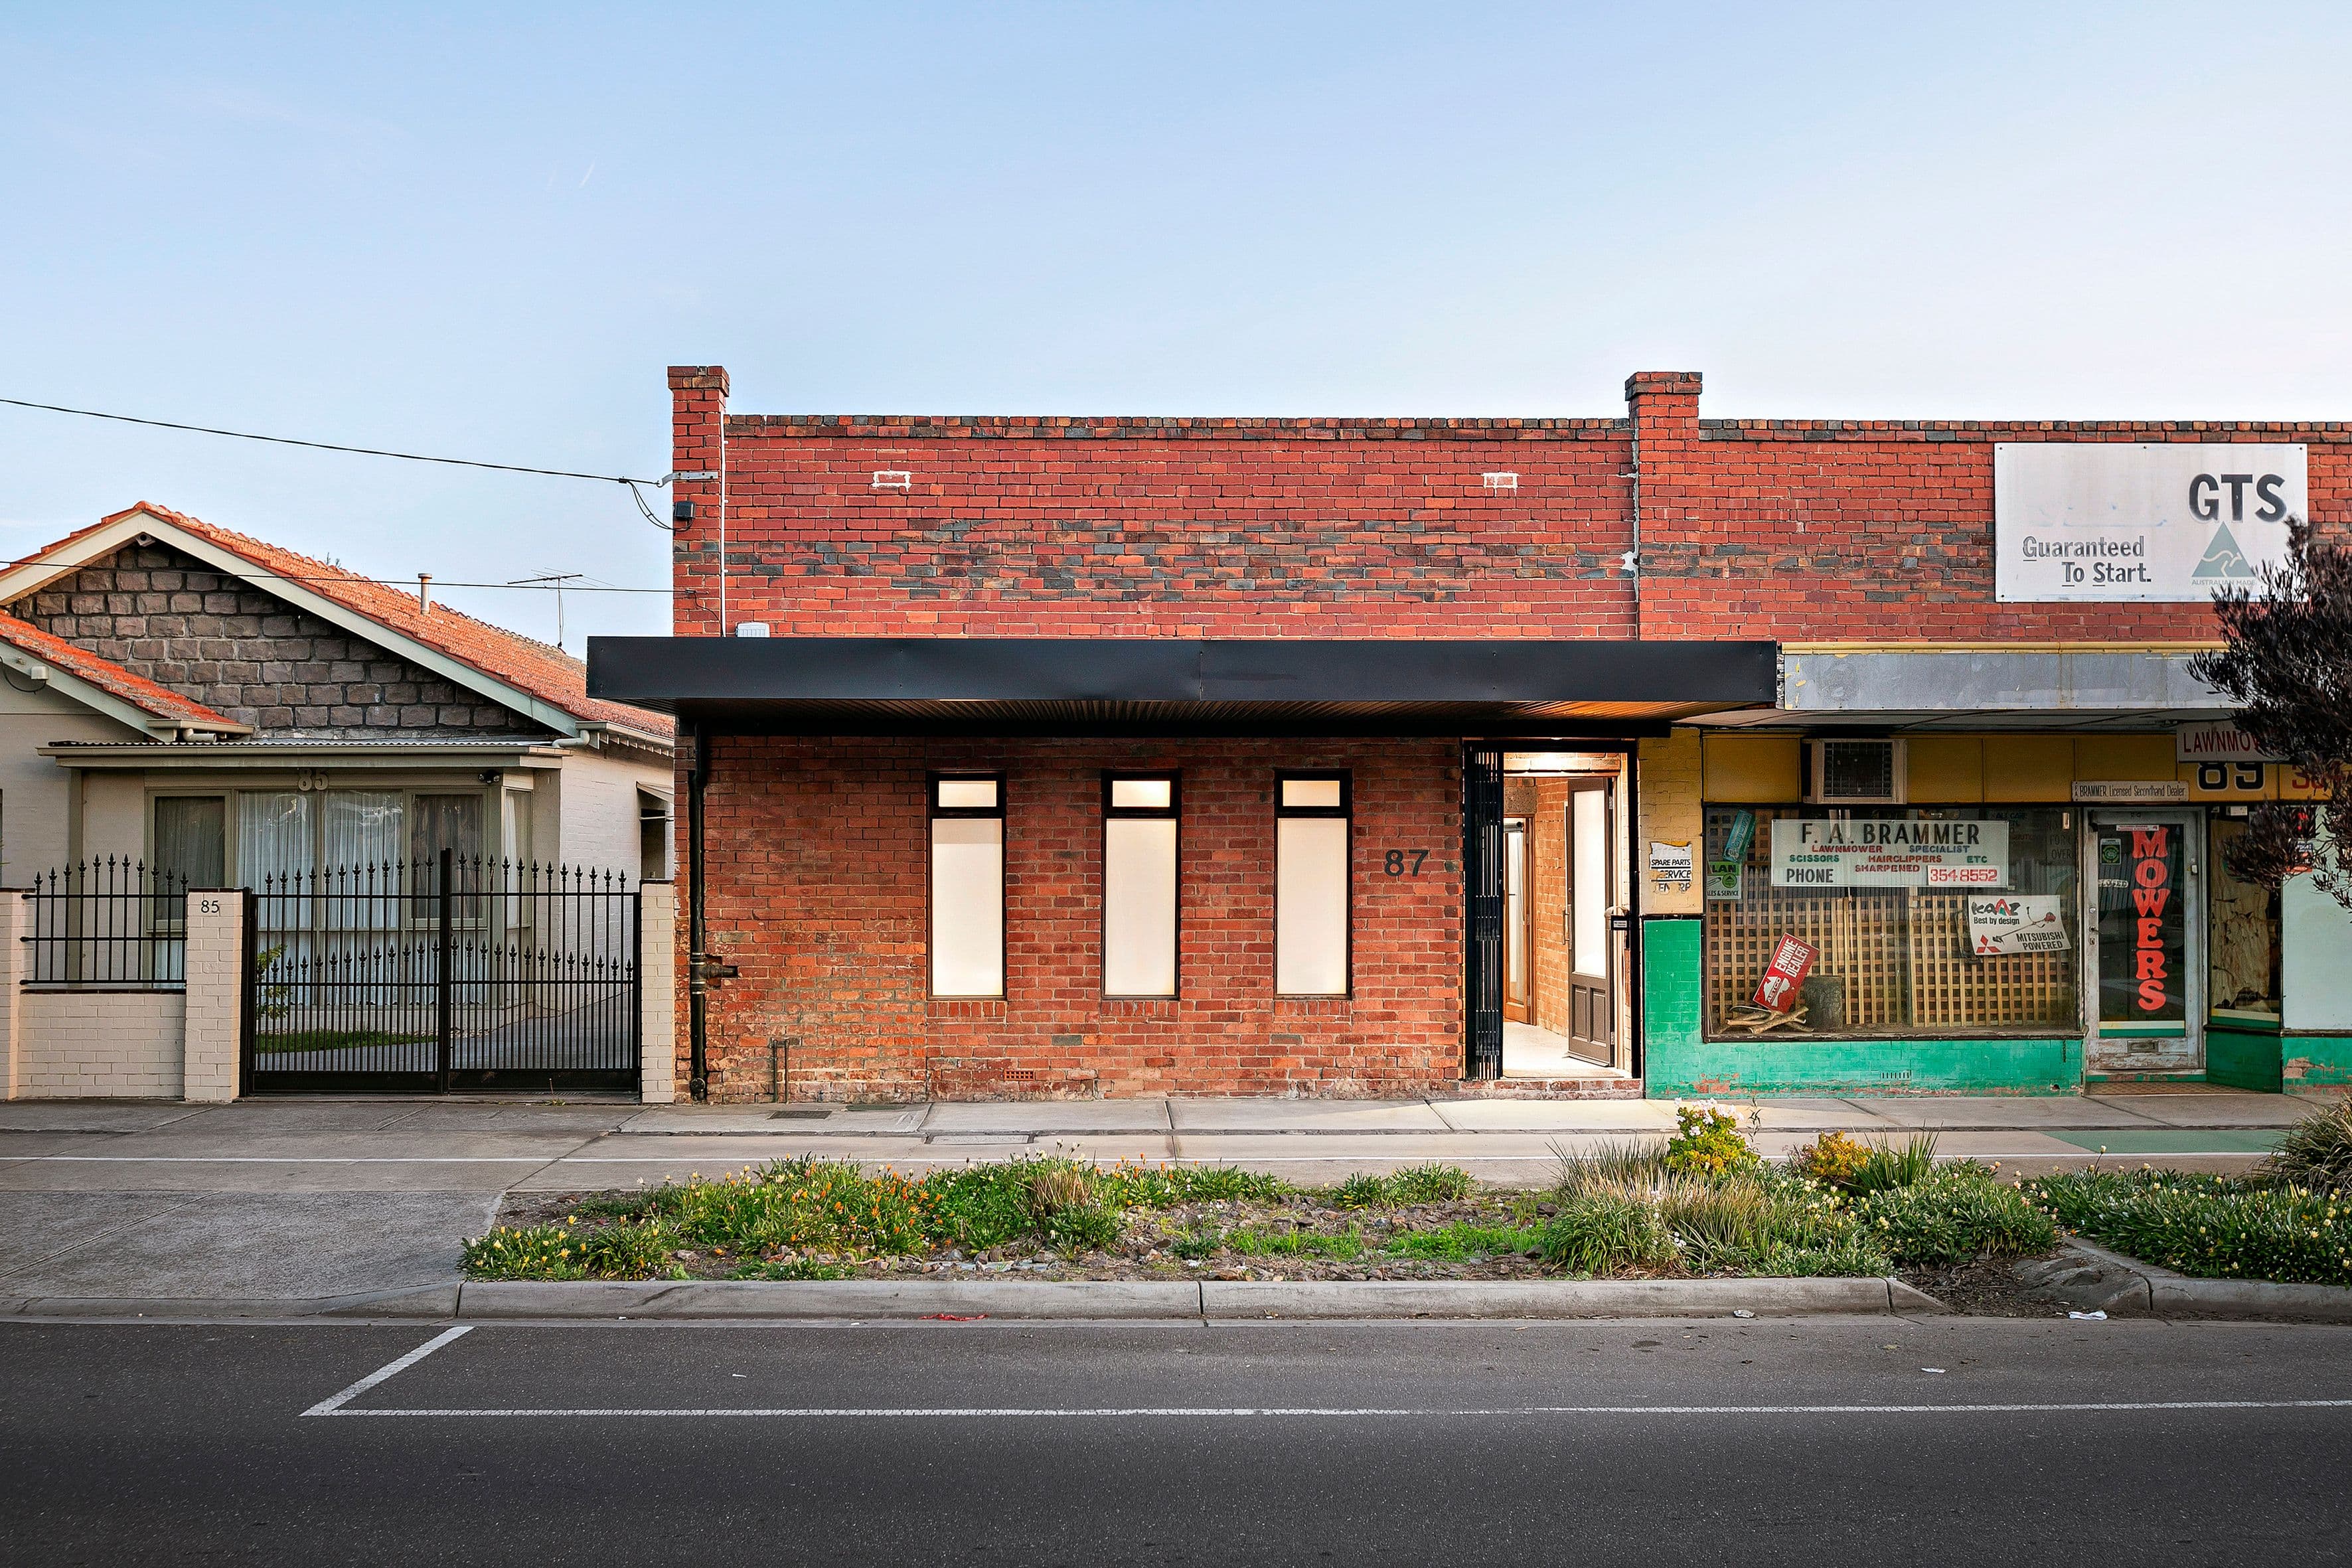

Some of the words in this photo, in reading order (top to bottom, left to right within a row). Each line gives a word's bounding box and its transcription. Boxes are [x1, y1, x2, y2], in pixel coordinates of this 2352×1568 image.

[2189, 473, 2288, 523] GTS
[2023, 536, 2146, 561] Guaranteed
[2061, 562, 2085, 587] To
[2092, 562, 2152, 587] Start.
[2197, 762, 2265, 791] 89
[2109, 785, 2132, 797] Licensed
[2134, 785, 2165, 797] Secondhand
[2167, 785, 2185, 797] Dealer
[1802, 823, 1818, 844] F.
[1828, 823, 1854, 844] A.
[1863, 823, 1980, 844] BRAMMER
[1385, 849, 1429, 877] 87
[1660, 870, 1691, 879] ERVICE
[1855, 864, 1920, 873] SHARPENED
[1786, 868, 1834, 883] PHONE
[201, 900, 219, 913] 85
[2132, 826, 2171, 1010] MOWERS
[2016, 931, 2065, 943] MITSUBISHI
[2023, 941, 2063, 951] POWERED
[1774, 938, 1798, 973] ENGINE
[1784, 945, 1810, 978] DEALER
